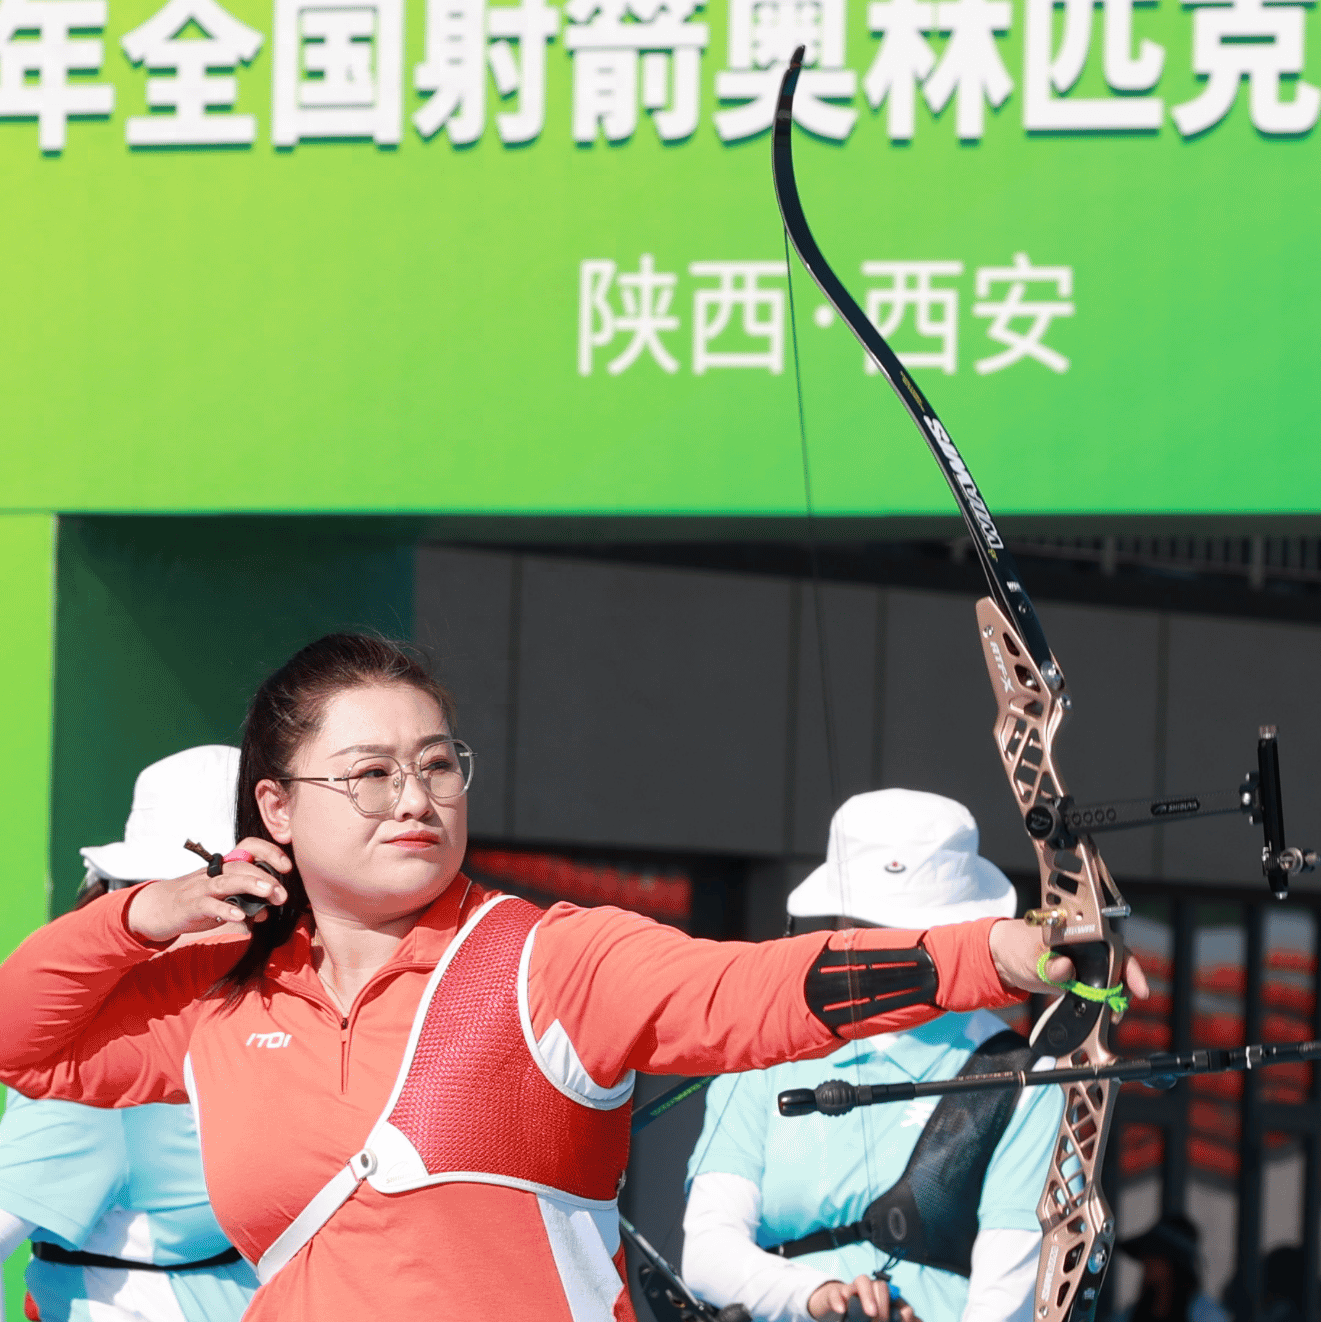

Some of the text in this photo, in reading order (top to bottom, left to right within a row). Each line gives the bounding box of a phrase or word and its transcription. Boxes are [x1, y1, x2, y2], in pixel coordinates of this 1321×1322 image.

[576, 254, 1076, 378] 陕西·西安
[924, 414, 1004, 550] WIAWIS
